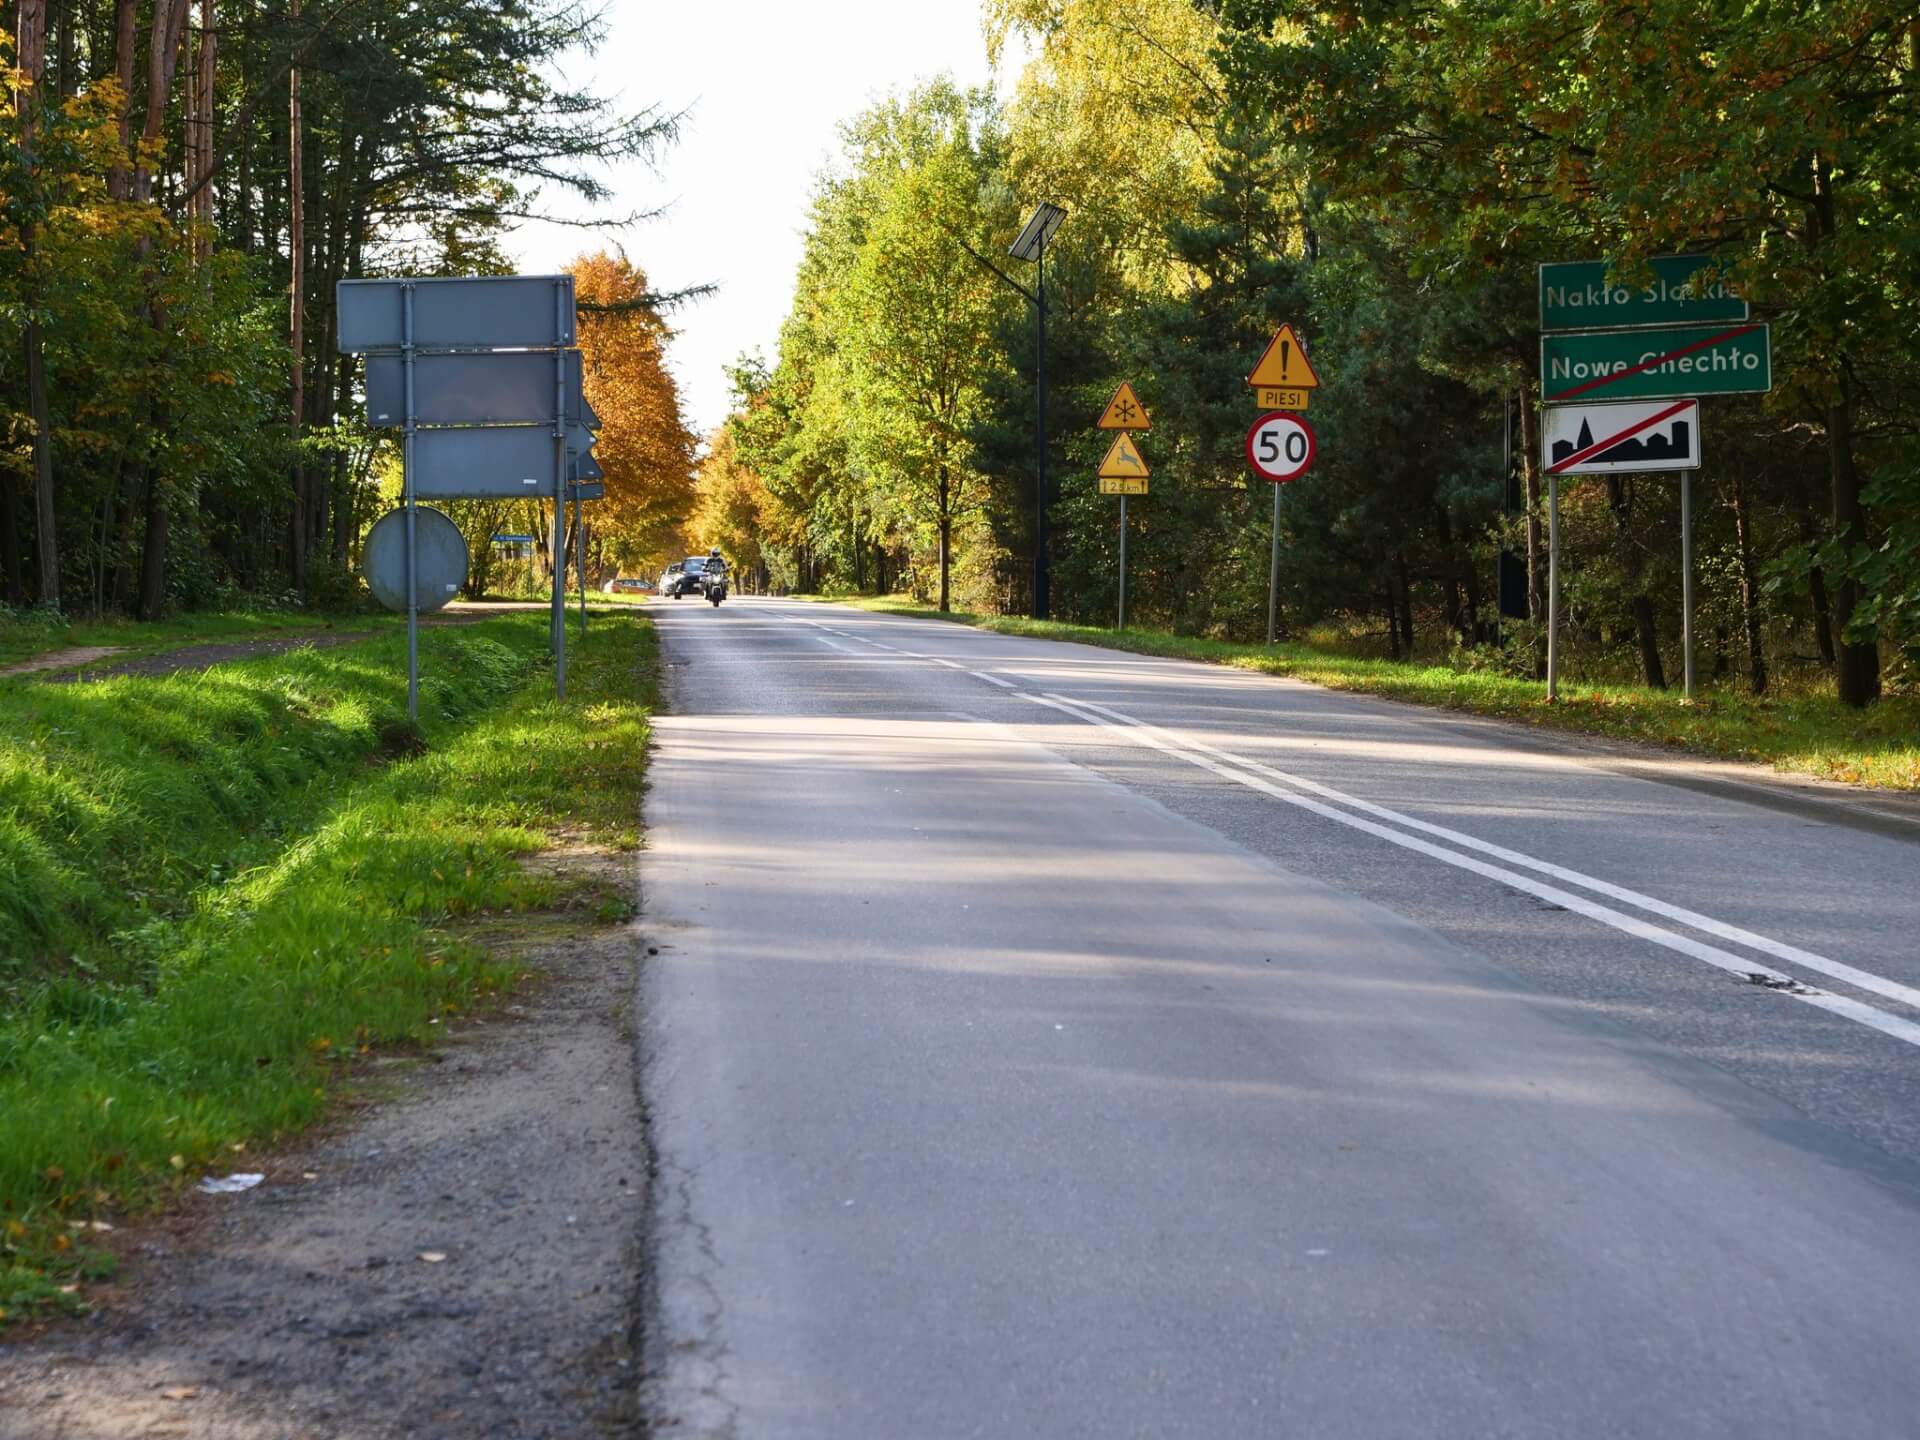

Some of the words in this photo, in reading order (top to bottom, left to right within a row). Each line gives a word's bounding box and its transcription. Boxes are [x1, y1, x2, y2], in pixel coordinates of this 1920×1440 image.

[1551, 357, 1628, 379] Nowe
[1638, 347, 1759, 375] Chechło
[1265, 392, 1301, 405] PIESI
[1259, 432, 1308, 463] 50
